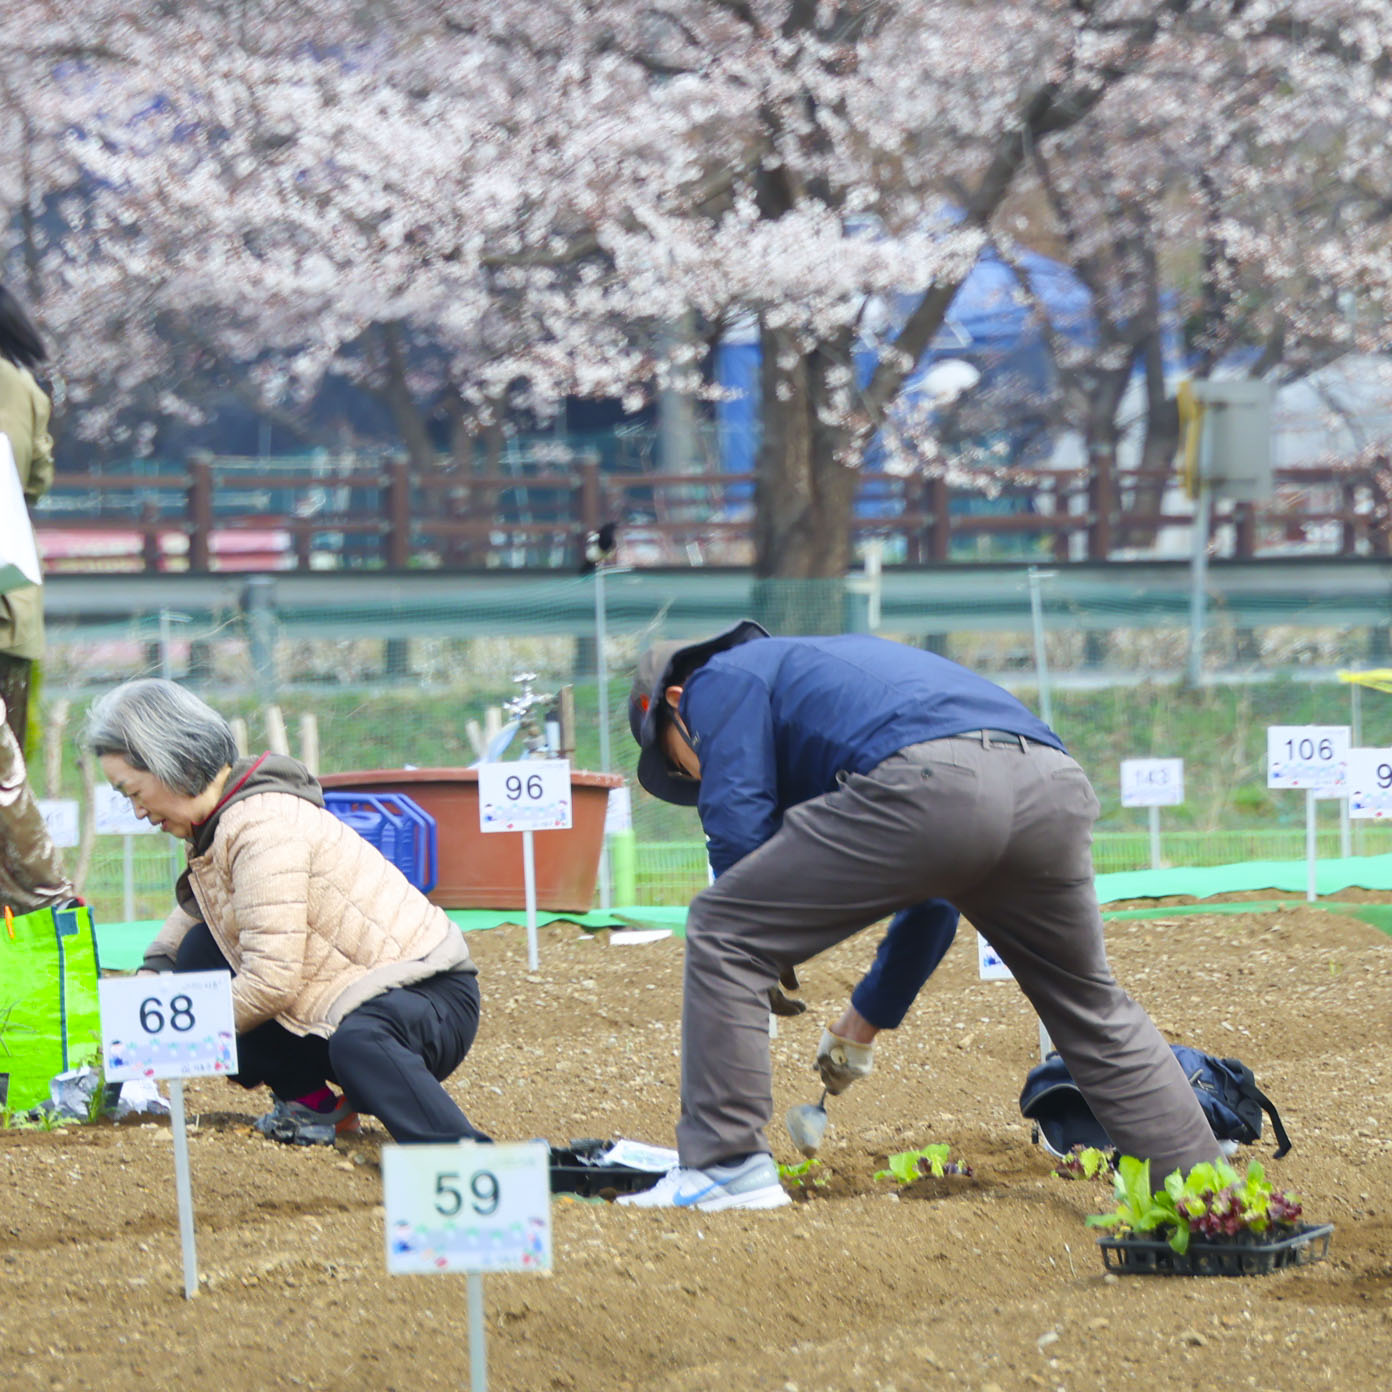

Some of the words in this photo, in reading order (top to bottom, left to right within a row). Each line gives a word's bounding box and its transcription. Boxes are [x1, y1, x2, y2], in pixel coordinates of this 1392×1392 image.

[1285, 738, 1334, 761] 106
[505, 774, 543, 801] 96
[139, 994, 196, 1034] 68
[433, 1169, 501, 1217] 59
